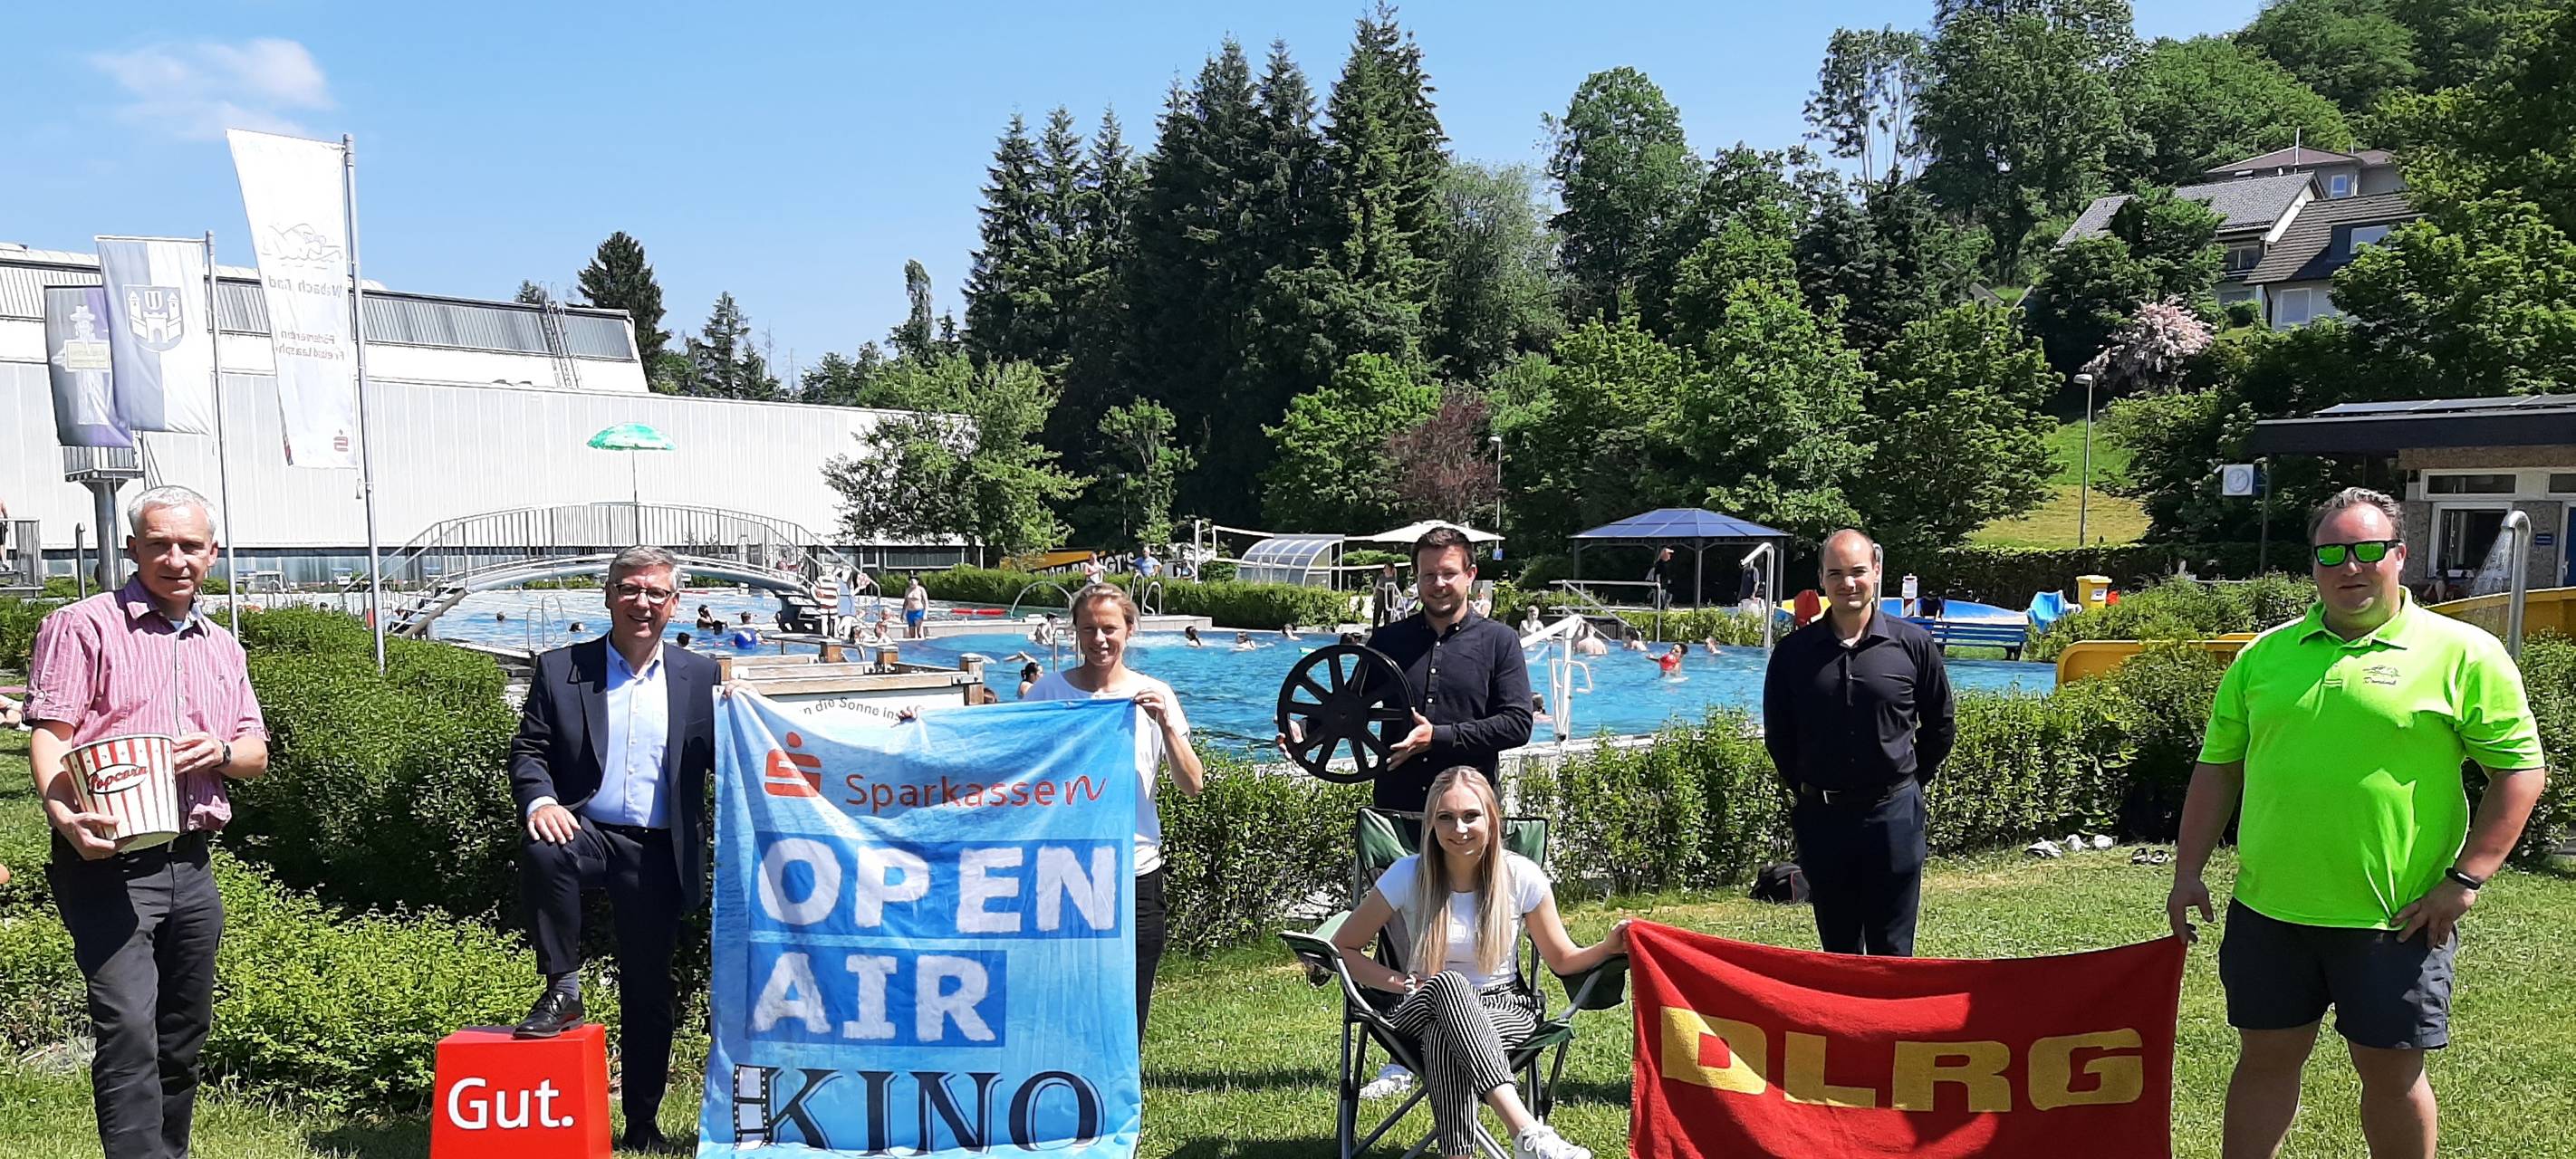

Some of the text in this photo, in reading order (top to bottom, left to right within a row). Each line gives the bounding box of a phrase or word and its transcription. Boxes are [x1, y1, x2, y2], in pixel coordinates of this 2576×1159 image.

[845, 774, 1107, 814] Sparkassen
[757, 838, 1116, 934] OPEN
[751, 953, 996, 1042] AIR
[447, 1077, 574, 1130] Gut.
[1660, 1006, 2143, 1113] DLRG
[734, 1064, 1105, 1158] KINO
